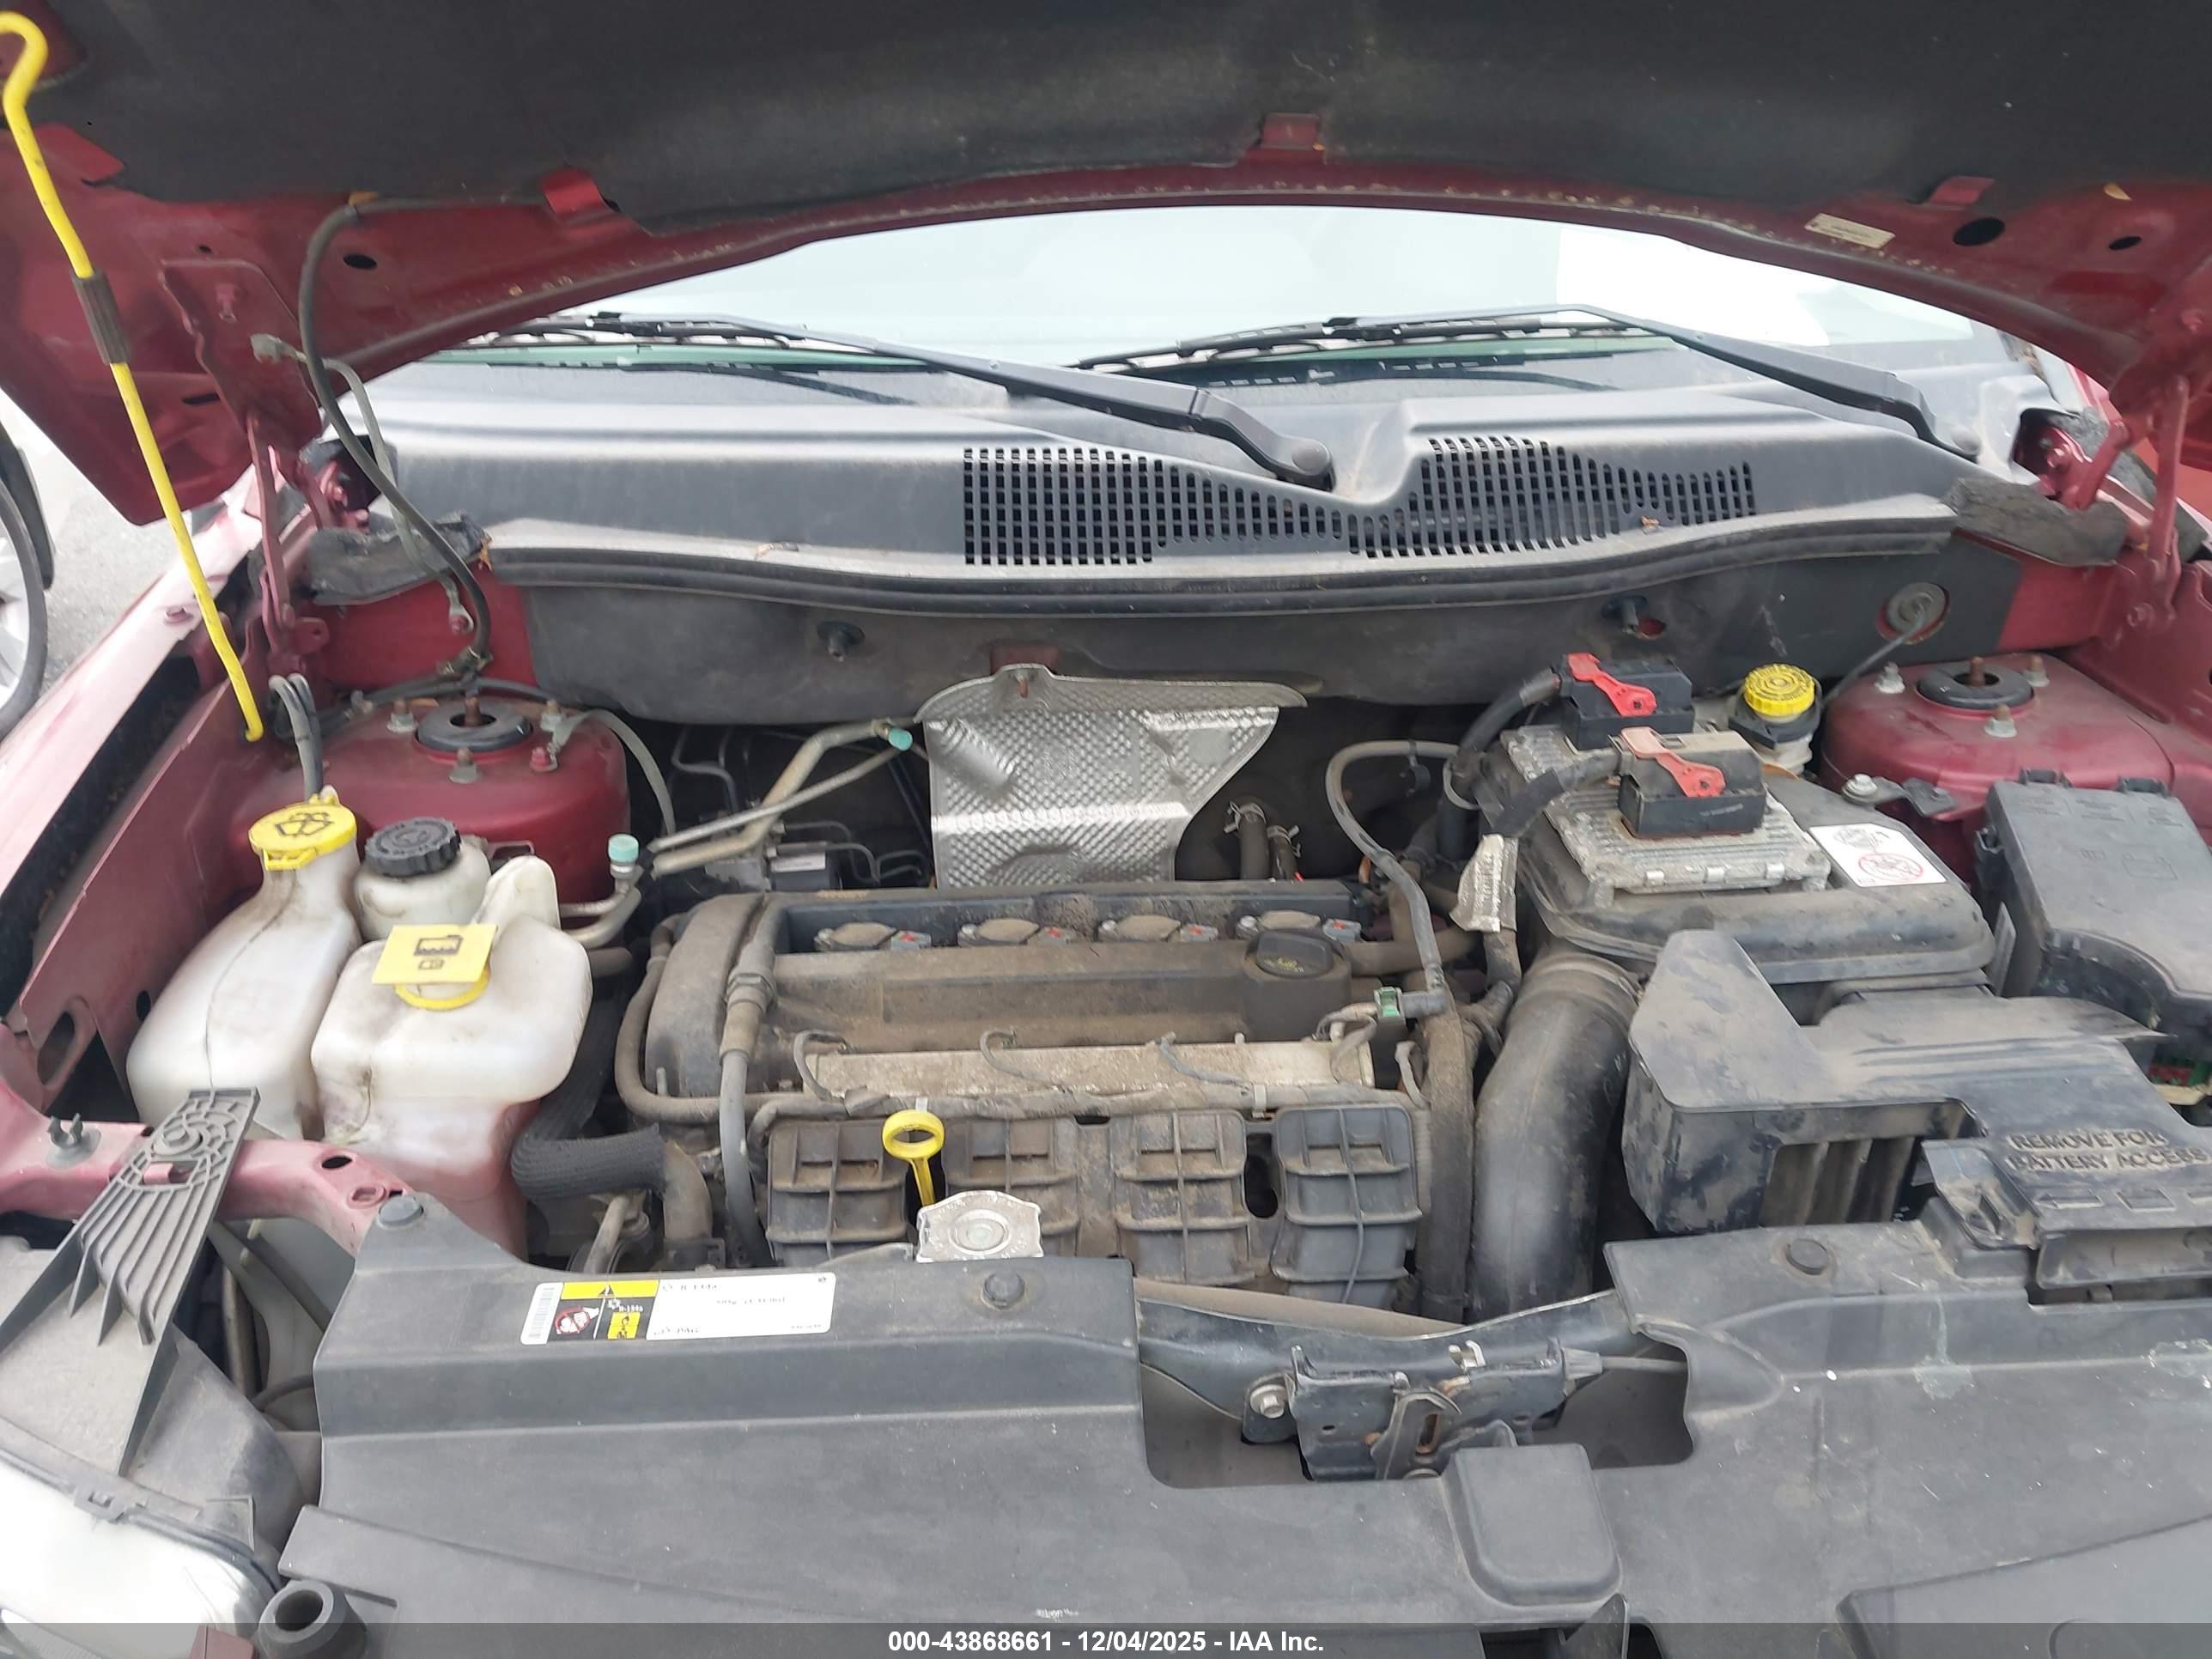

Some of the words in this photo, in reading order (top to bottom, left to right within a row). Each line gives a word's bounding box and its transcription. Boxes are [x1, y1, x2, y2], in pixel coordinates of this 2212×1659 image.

[2006, 1131, 2112, 1151] REMOVE
[2112, 1129, 2169, 1147] FOR
[2005, 1154, 2109, 1170] BATTERY
[2116, 1148, 2211, 1170] ACCESS
